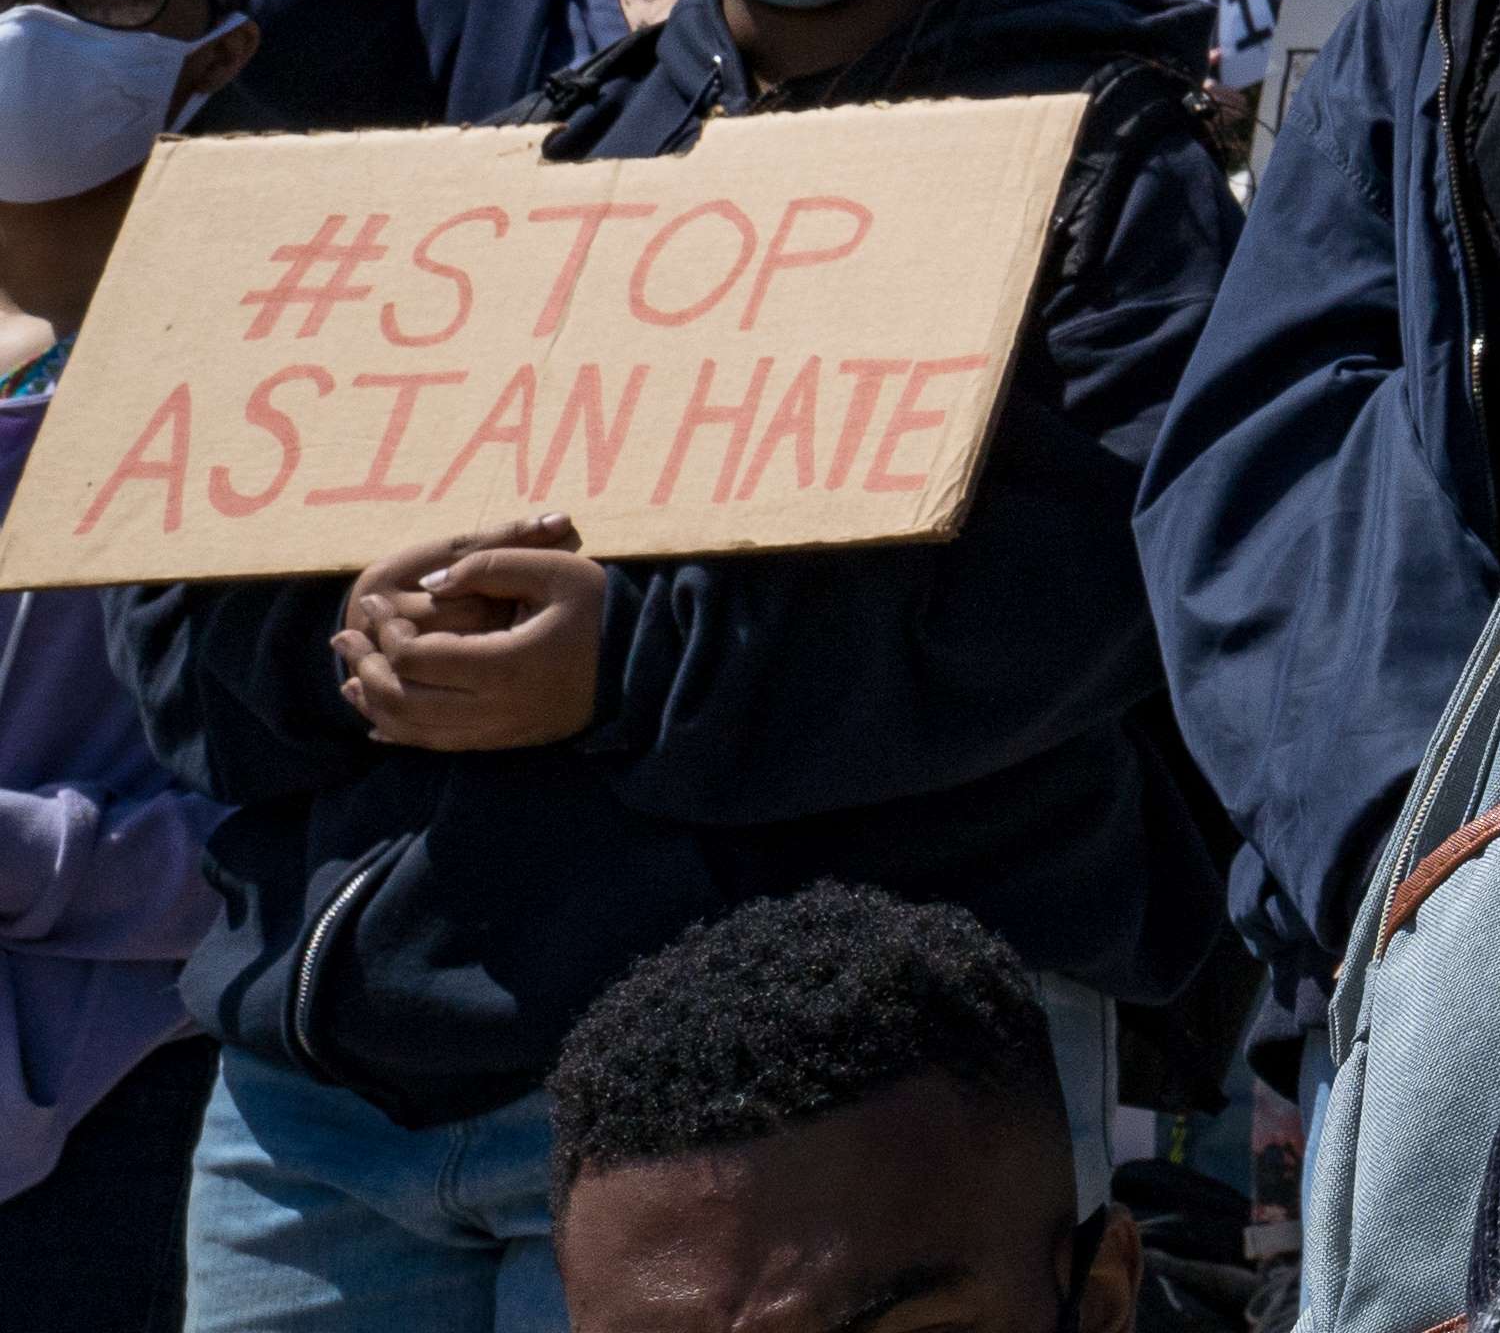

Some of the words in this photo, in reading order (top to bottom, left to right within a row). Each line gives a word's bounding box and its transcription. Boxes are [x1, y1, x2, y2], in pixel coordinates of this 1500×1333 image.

[238, 195, 874, 349] #STOP
[73, 360, 651, 535] ASIAN
[650, 351, 992, 508] HATE
